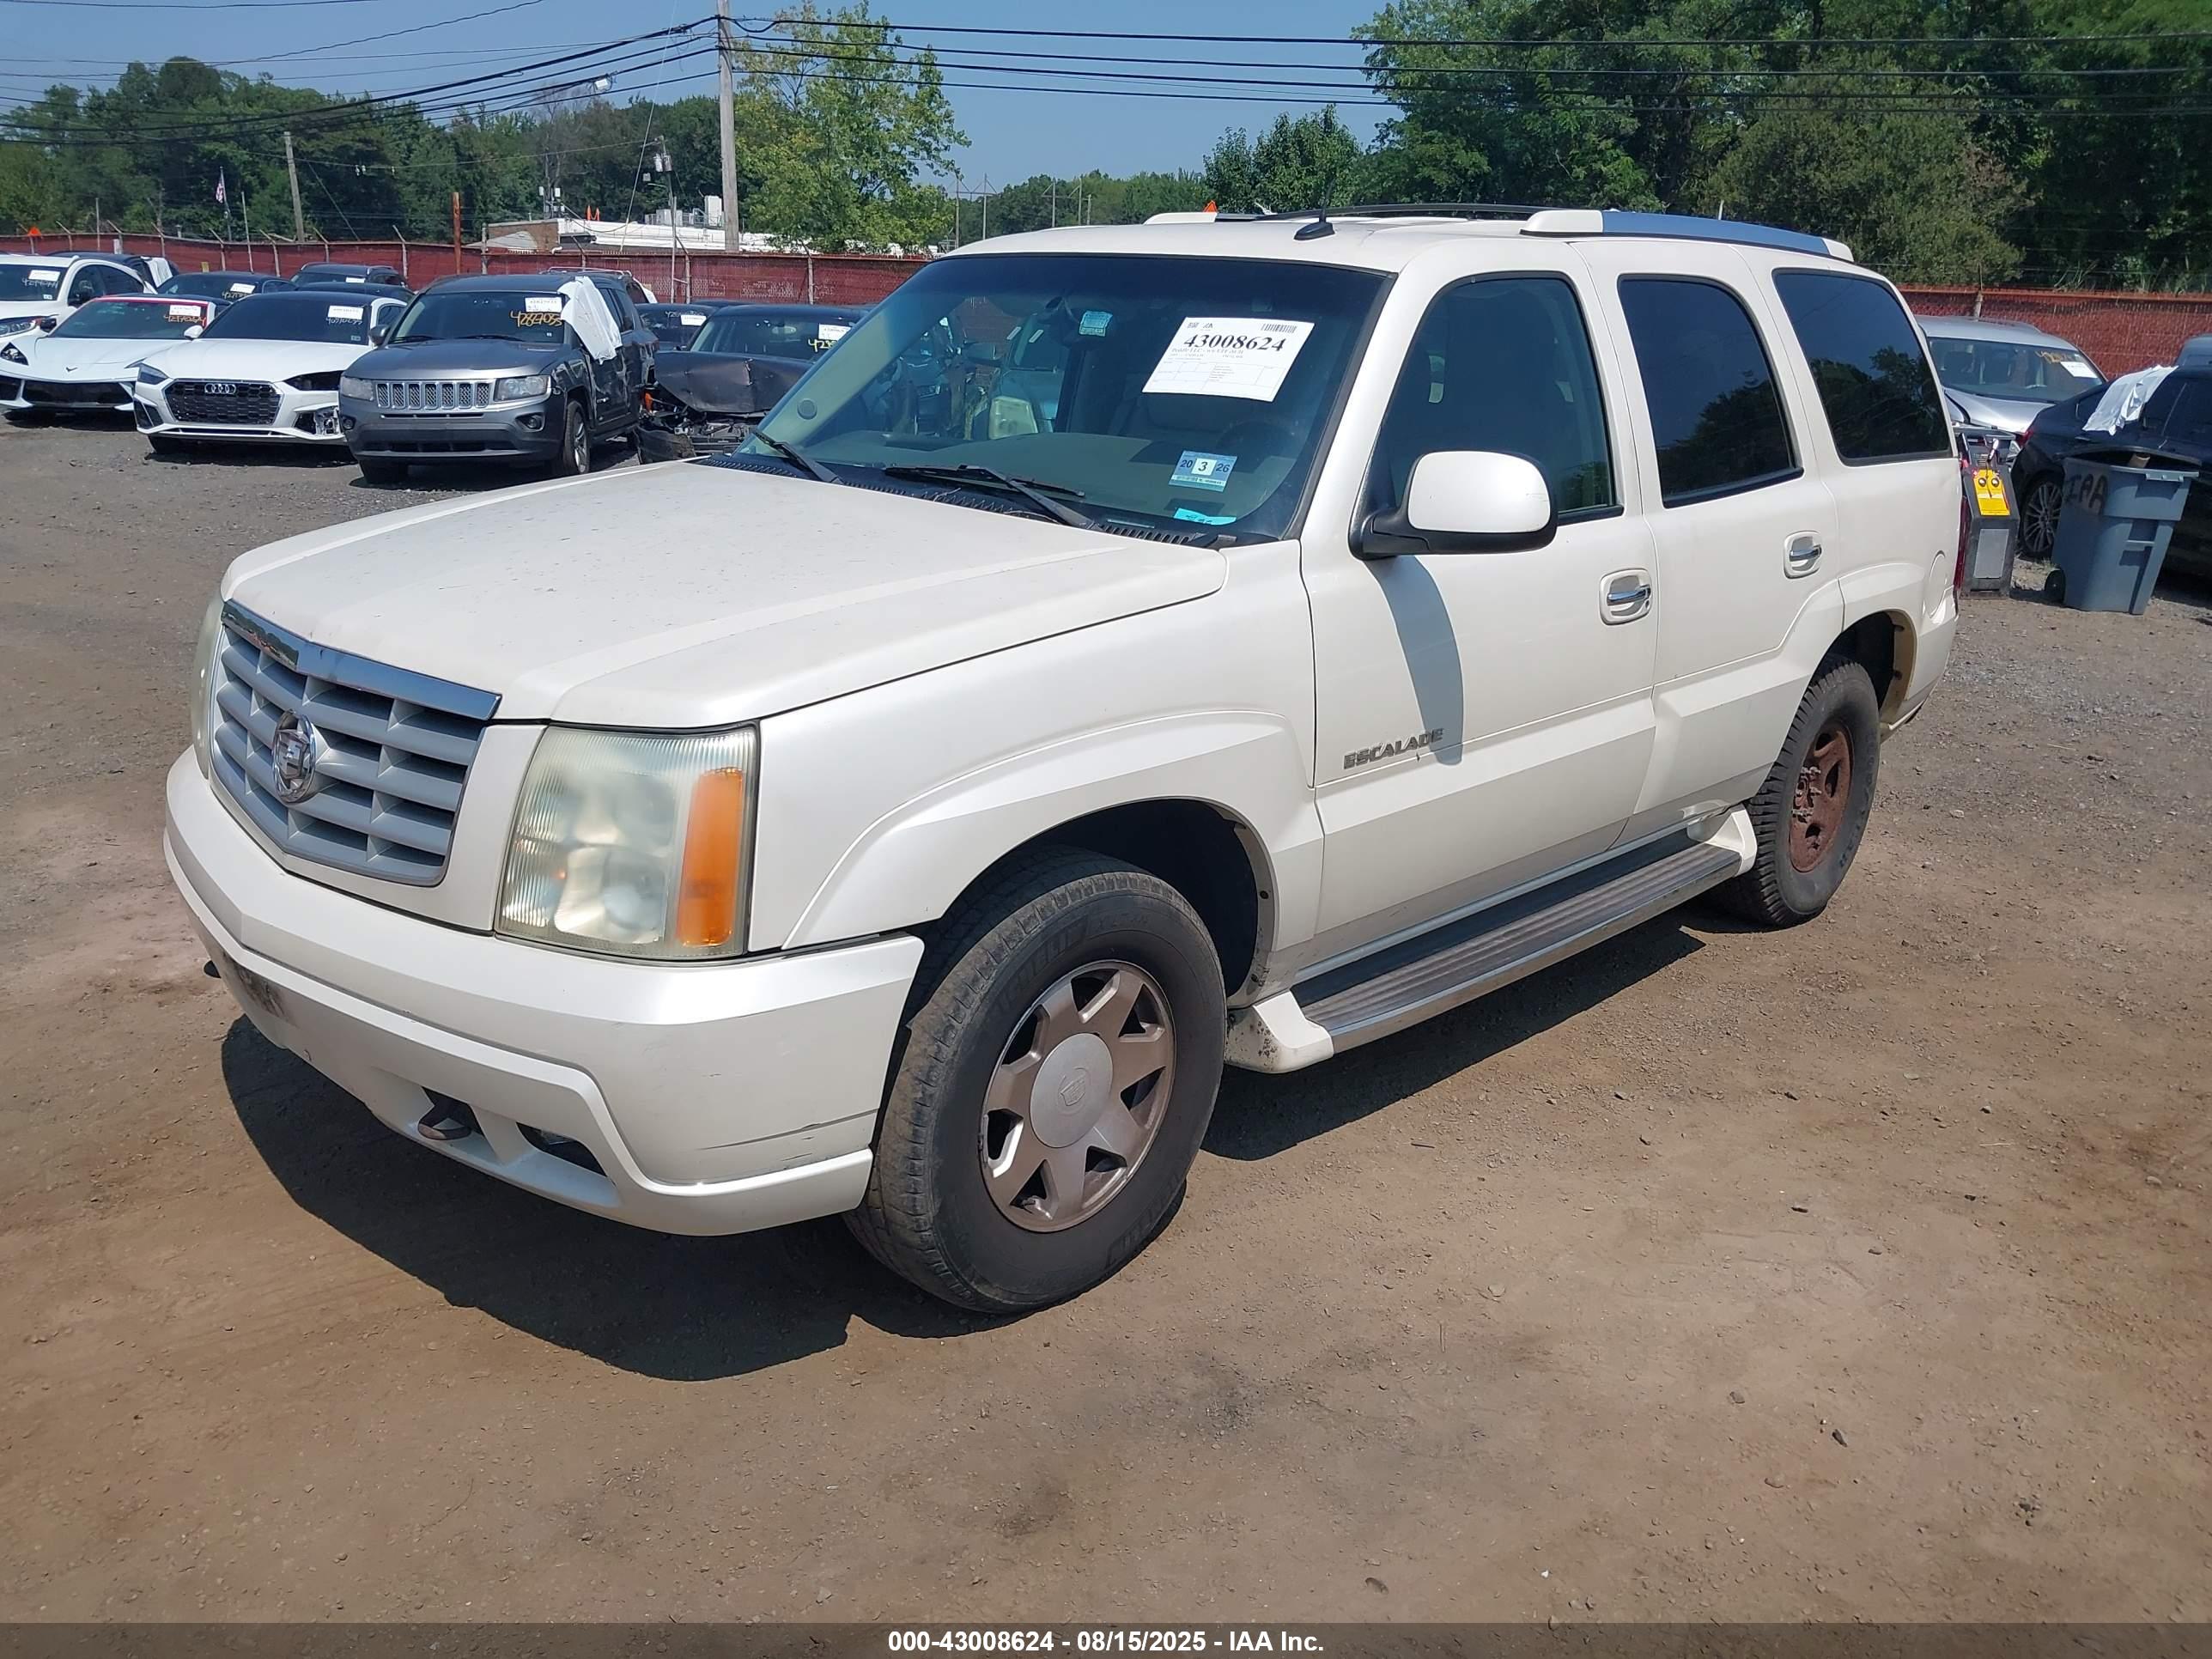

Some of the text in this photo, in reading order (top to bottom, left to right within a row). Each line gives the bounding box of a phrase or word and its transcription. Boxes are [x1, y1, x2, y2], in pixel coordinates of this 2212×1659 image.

[1183, 334, 1287, 352] 43008624
[1198, 462, 1208, 471] 3
[1216, 464, 1231, 472] 26
[1343, 728, 1444, 769] ESCALADE
